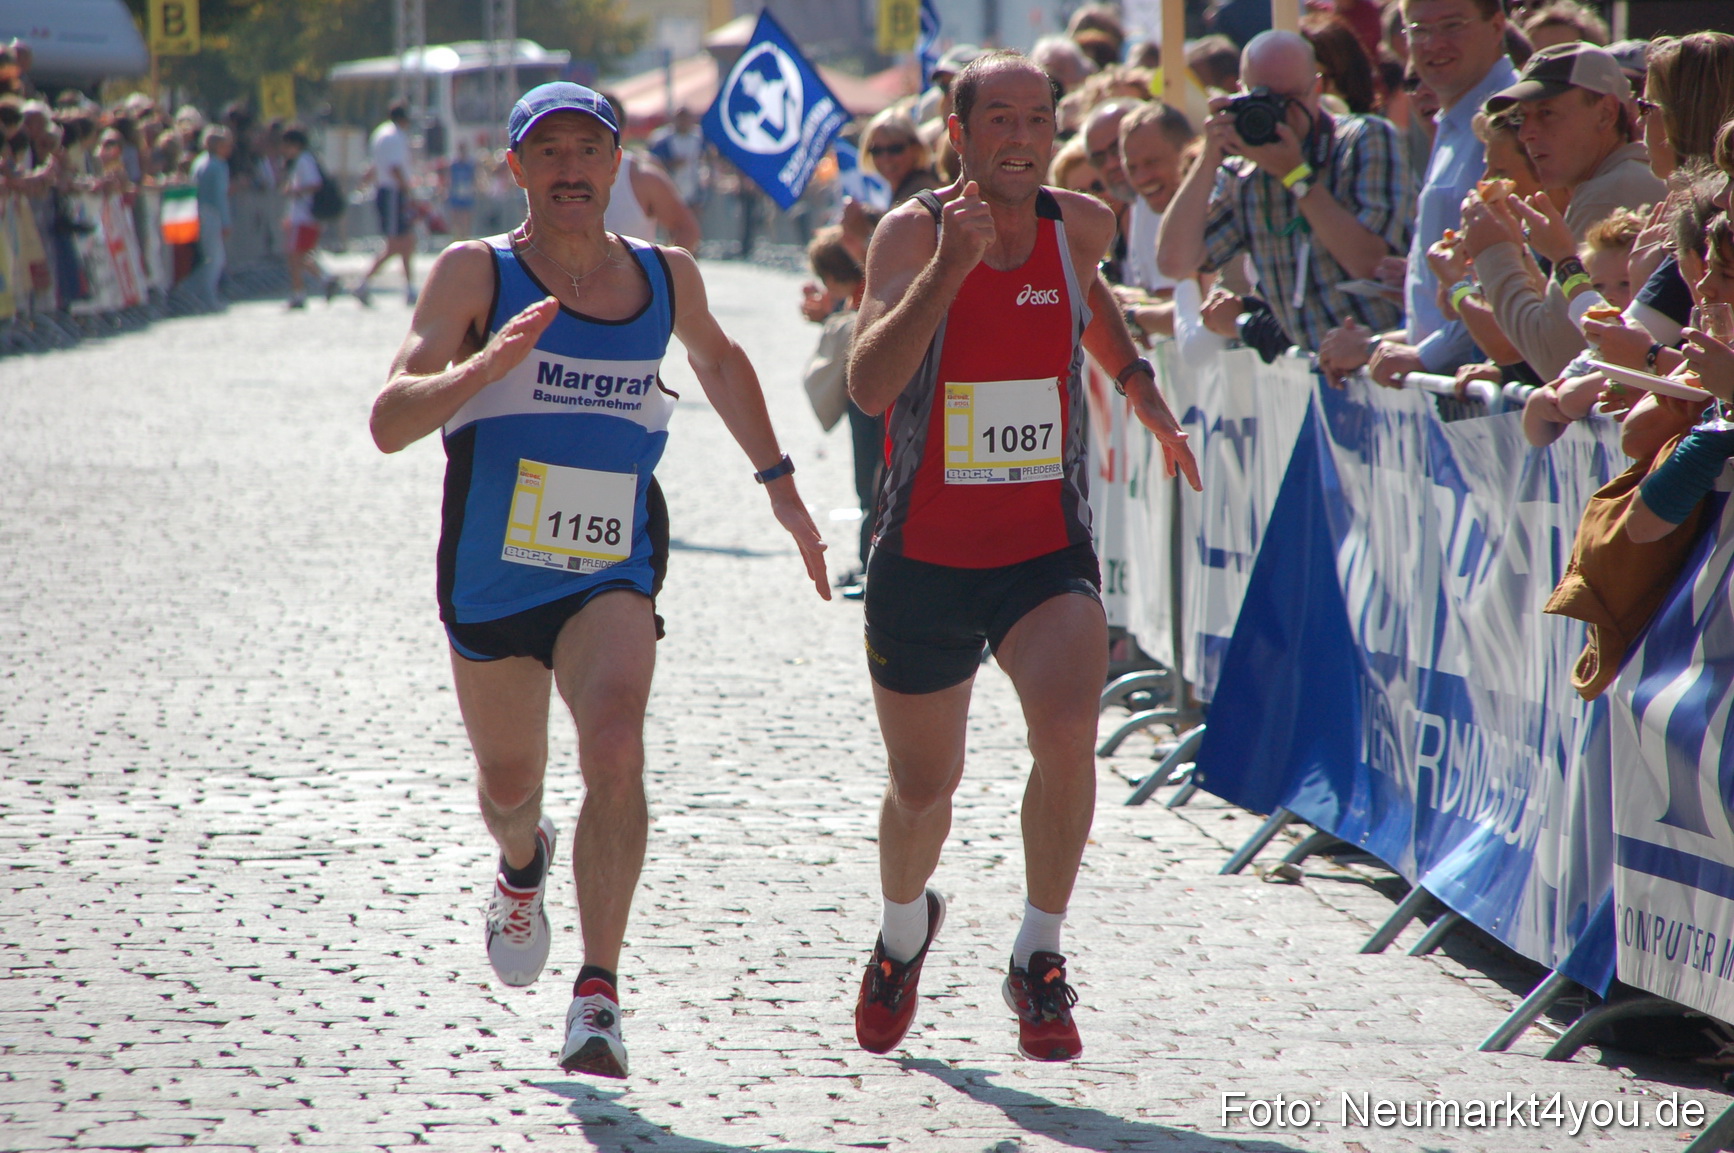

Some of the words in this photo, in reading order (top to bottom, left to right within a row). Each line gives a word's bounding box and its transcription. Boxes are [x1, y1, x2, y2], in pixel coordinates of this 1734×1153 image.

[163, 3, 187, 37] B
[537, 361, 655, 397] Margraf
[983, 423, 1053, 453] 1087
[947, 468, 993, 479] BOCK
[1022, 463, 1061, 476] PFLEIDERER
[548, 511, 621, 546] 1158
[504, 546, 552, 562] BOCK
[1617, 903, 1716, 974] COMPUTER
